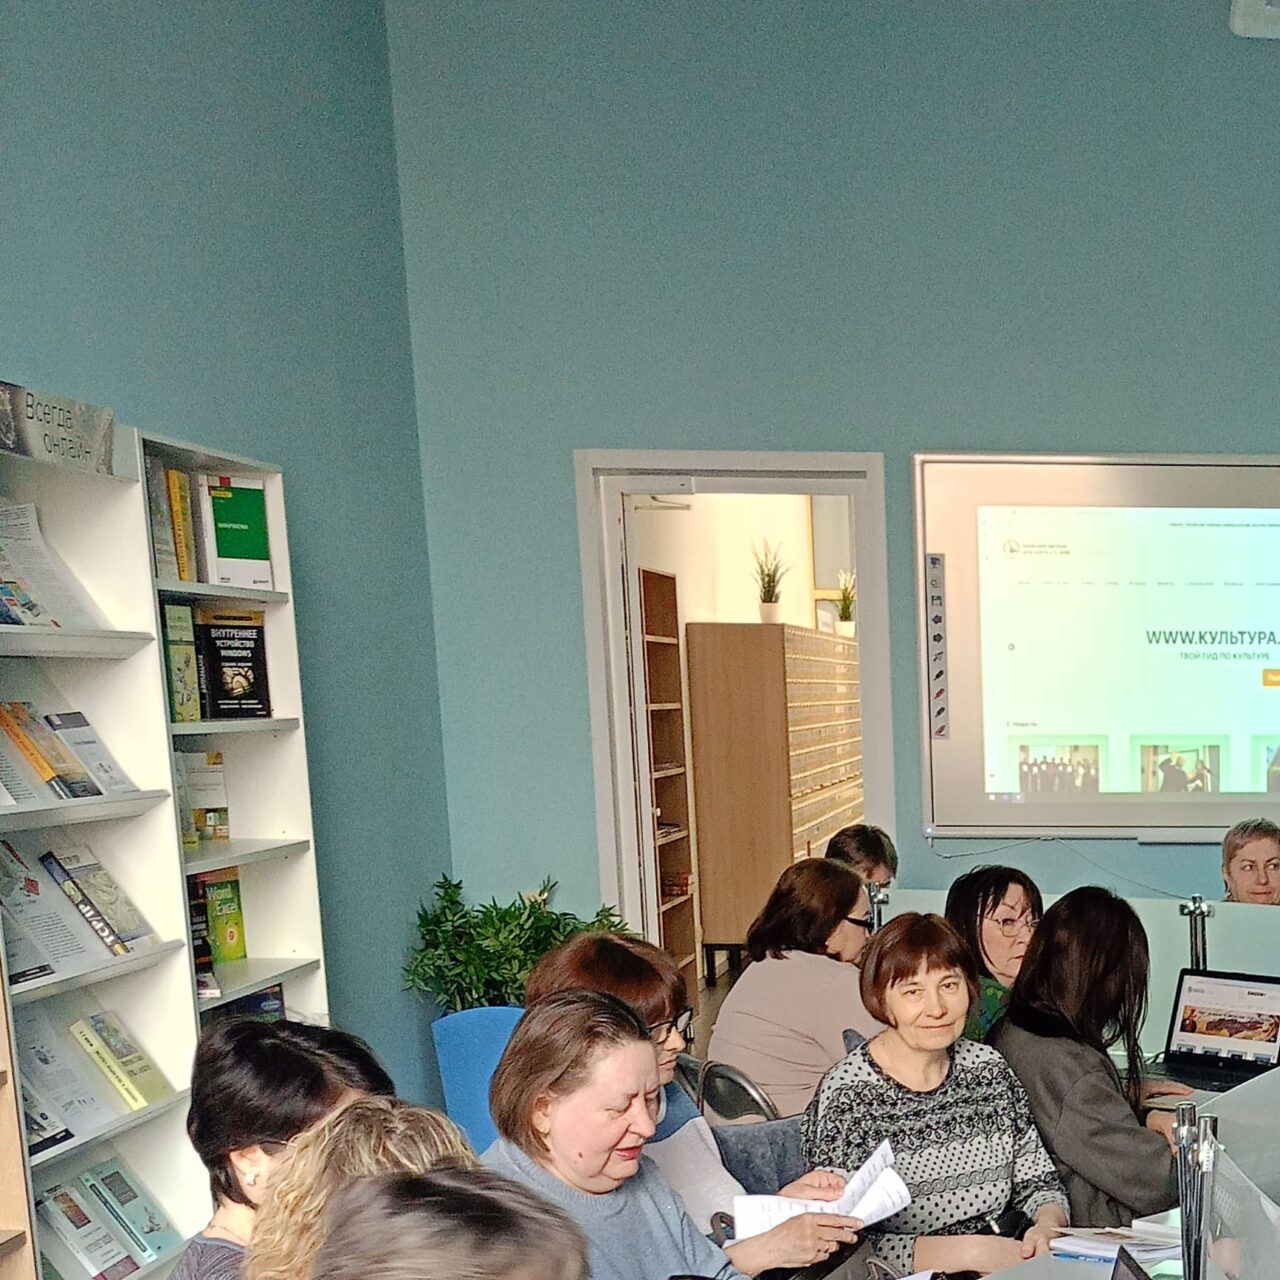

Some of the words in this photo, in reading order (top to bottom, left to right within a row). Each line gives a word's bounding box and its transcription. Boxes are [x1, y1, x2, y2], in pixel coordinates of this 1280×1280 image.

[25, 392, 73, 431] Всегда
[1232, 652, 1270, 660] КУЛЬТУРЕ
[78, 903, 116, 946] TCP/IP
